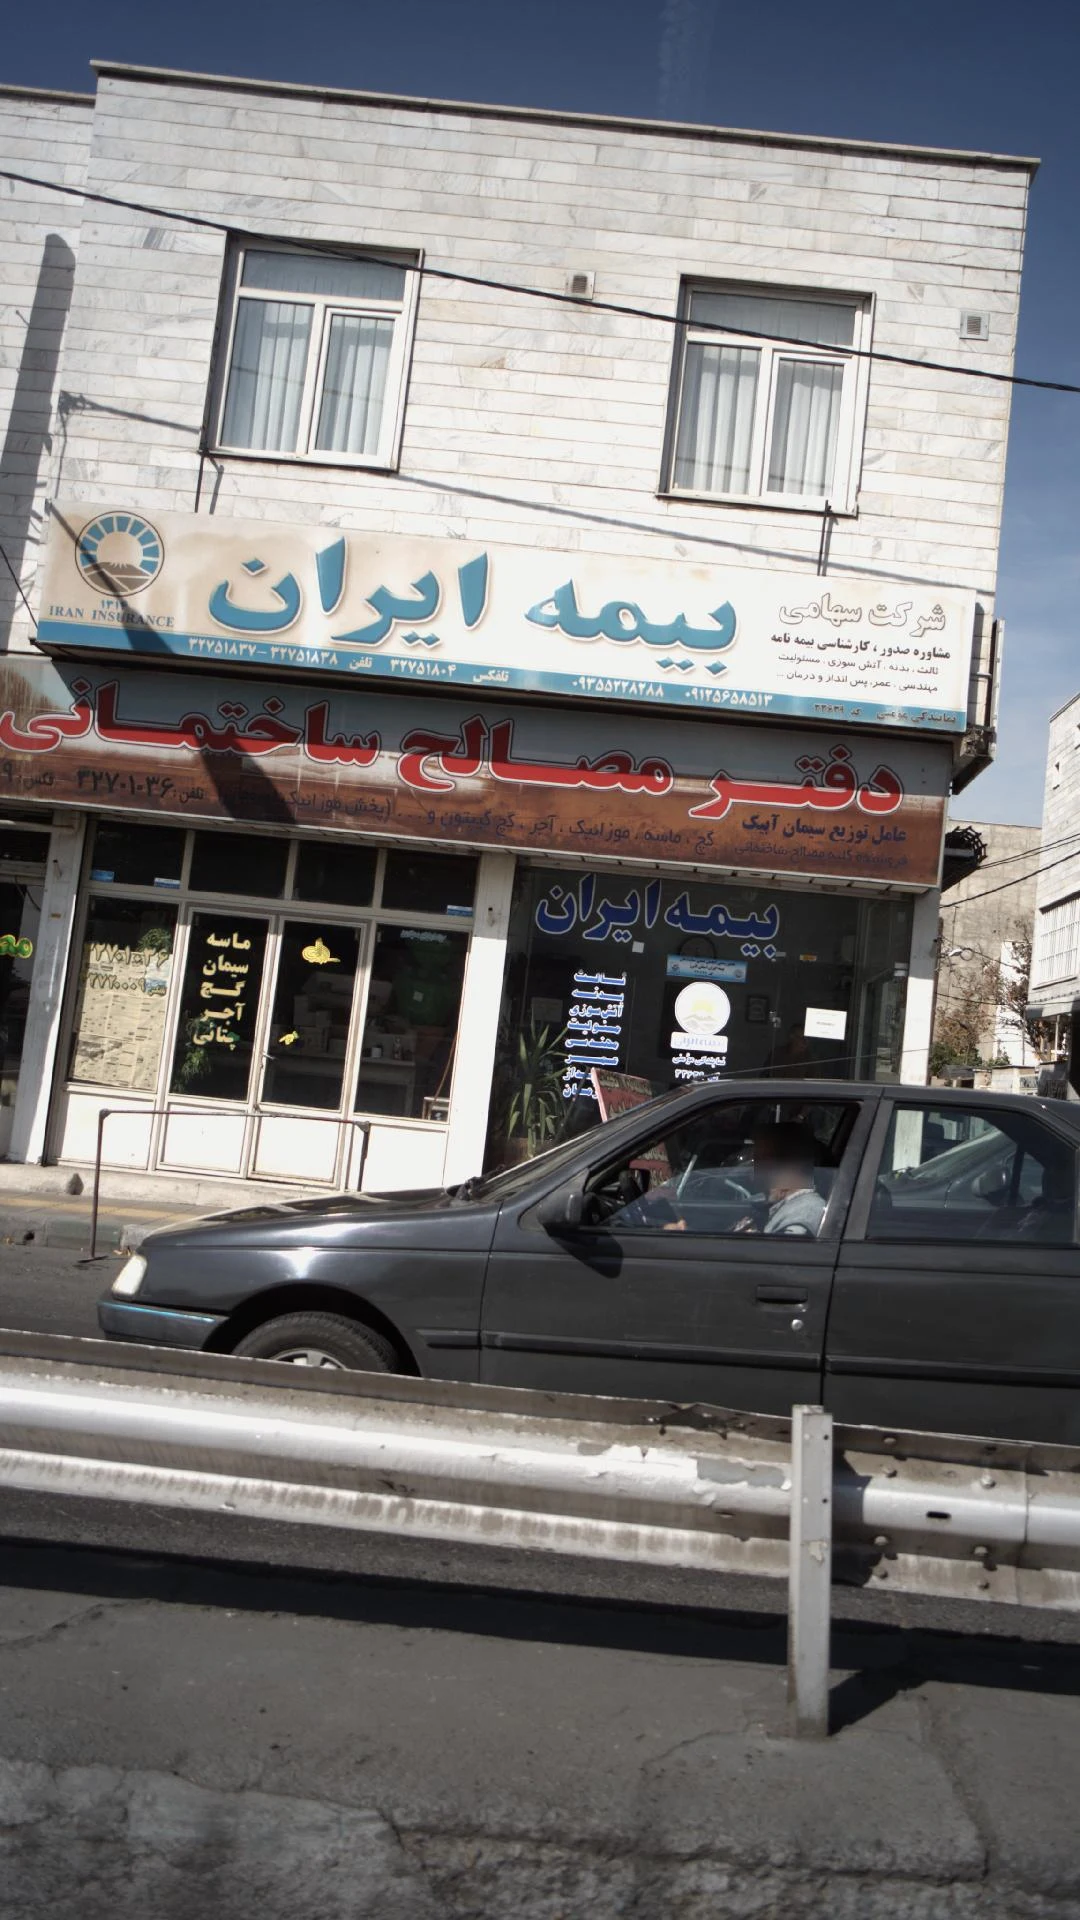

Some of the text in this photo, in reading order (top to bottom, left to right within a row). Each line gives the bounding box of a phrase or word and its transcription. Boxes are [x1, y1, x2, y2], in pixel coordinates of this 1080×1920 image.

[209, 535, 740, 677] بیمه ایران
[49, 605, 175, 627] IRAN INSURANCE
[779, 593, 946, 637] شرکت سهامی
[771, 633, 790, 644] نامه
[794, 636, 814, 648] بیمه
[817, 638, 870, 653] کارشناسی
[913, 646, 951, 660] مشاوره
[349, 657, 372, 670] تلفن
[828, 658, 855, 668] سوزی
[859, 660, 881, 670] آتش
[472, 670, 509, 682] تلفکس
[787, 670, 814, 680] درمان
[899, 683, 938, 693] مهندسی
[0, 678, 905, 821] دفتر مصالح ساختمانی
[783, 818, 825, 838] سیمان
[829, 824, 868, 844] توزیع
[871, 825, 907, 845] عامل
[535, 872, 779, 959] بیمه ایران
[206, 932, 251, 950] ماسه
[202, 954, 249, 978] سیمان
[574, 969, 627, 985] ثالث
[200, 980, 246, 998] گچ
[571, 986, 624, 1001] بدنه
[200, 1002, 246, 1025] آجر
